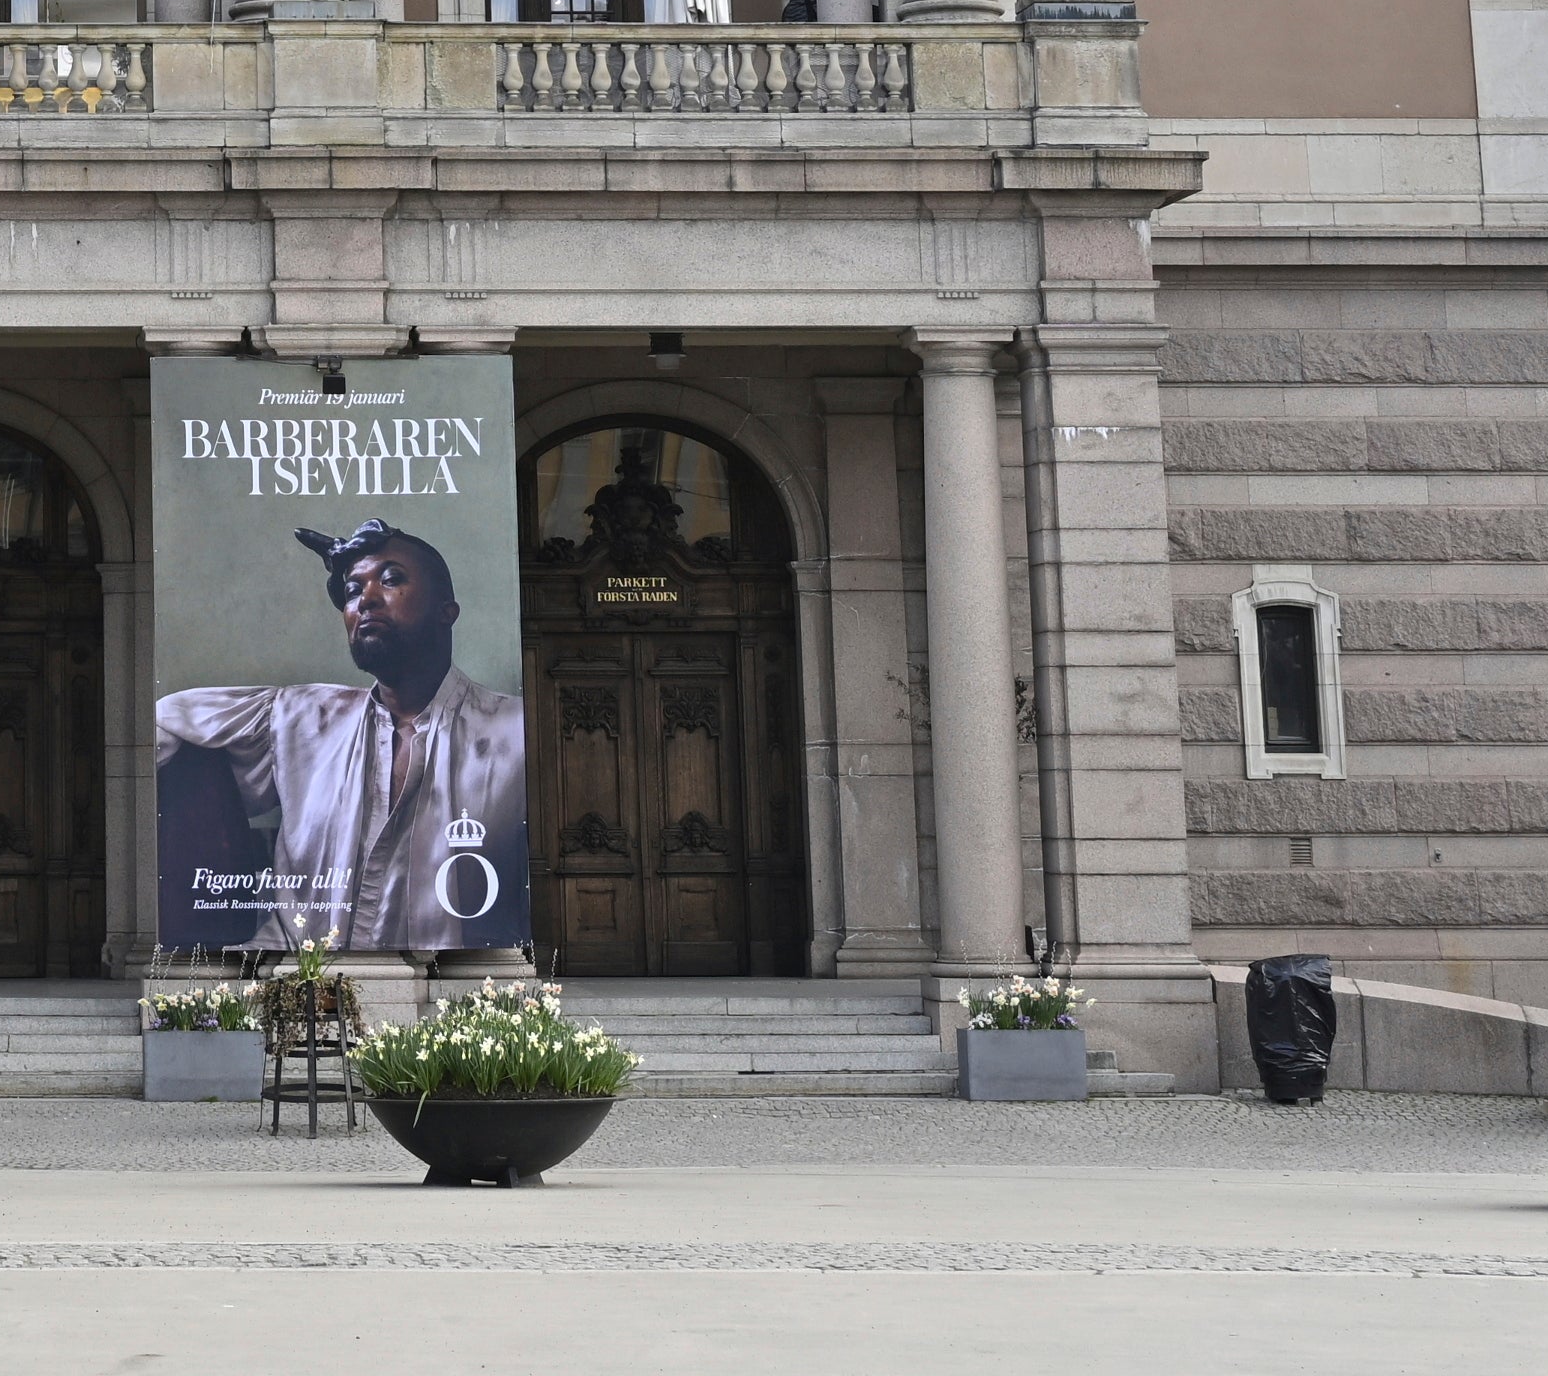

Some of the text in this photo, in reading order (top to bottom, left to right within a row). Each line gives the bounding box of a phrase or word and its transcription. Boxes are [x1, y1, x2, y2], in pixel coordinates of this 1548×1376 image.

[259, 388, 323, 405] Premiär
[344, 389, 405, 409] januari
[181, 417, 484, 459] BARBERAREN
[248, 456, 460, 495] I SEVILLA
[607, 577, 667, 588] PARKETT
[641, 591, 678, 602] RADEN
[192, 868, 352, 895] Figaro fixar allt!
[193, 899, 229, 910] Klassisk
[231, 899, 288, 912] Rossiniopera
[297, 901, 308, 912] ny
[311, 900, 353, 913] tappning
